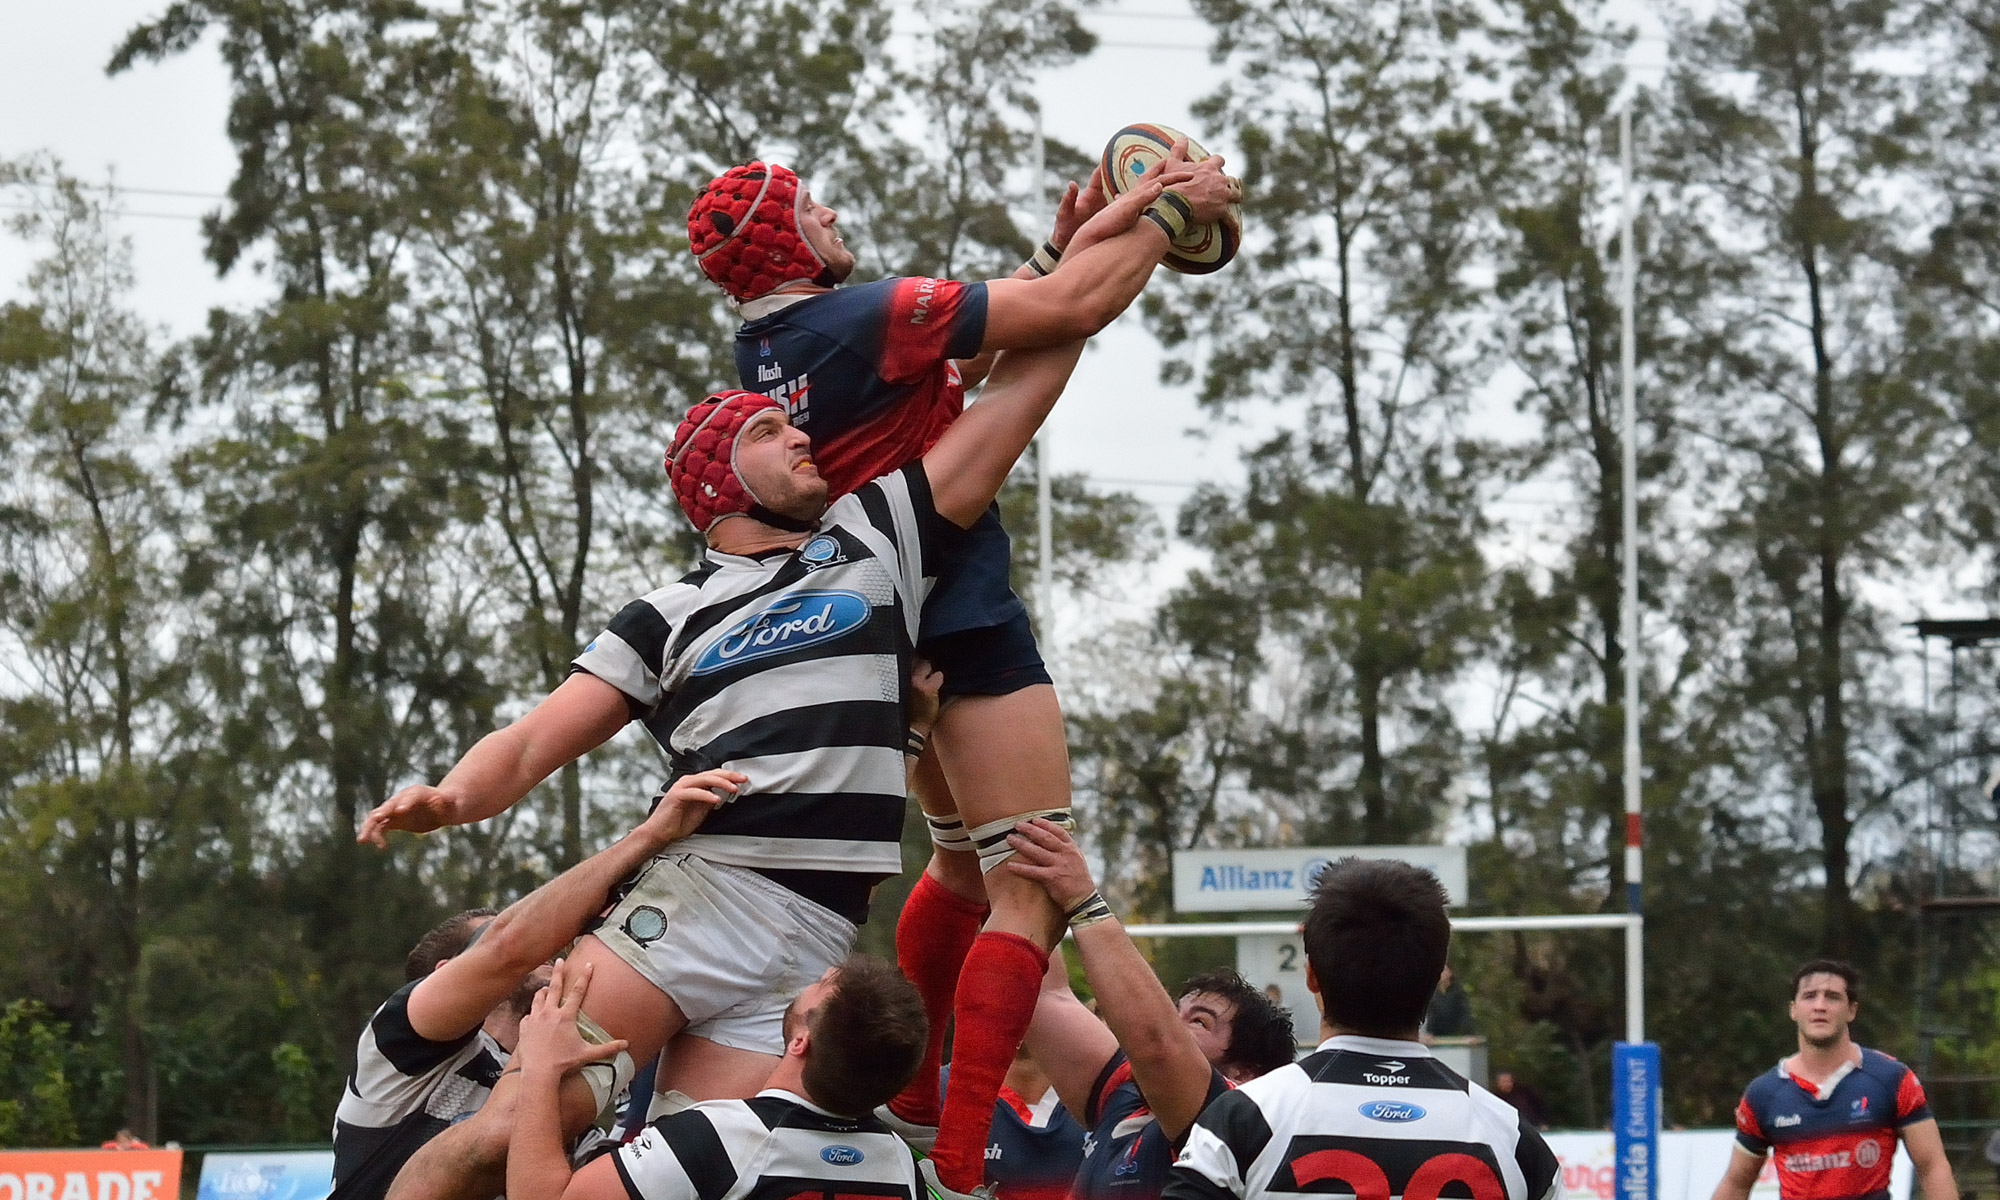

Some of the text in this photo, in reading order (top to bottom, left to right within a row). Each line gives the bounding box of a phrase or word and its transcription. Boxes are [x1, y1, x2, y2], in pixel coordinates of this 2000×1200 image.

[757, 361, 783, 383] flash
[718, 602, 837, 659] Ford
[1200, 865, 1294, 892] Allianz
[1278, 943, 1298, 972] 2
[1363, 1072, 1411, 1086] Topper
[1371, 1103, 1413, 1120] Ford
[828, 1148, 856, 1163] Ford
